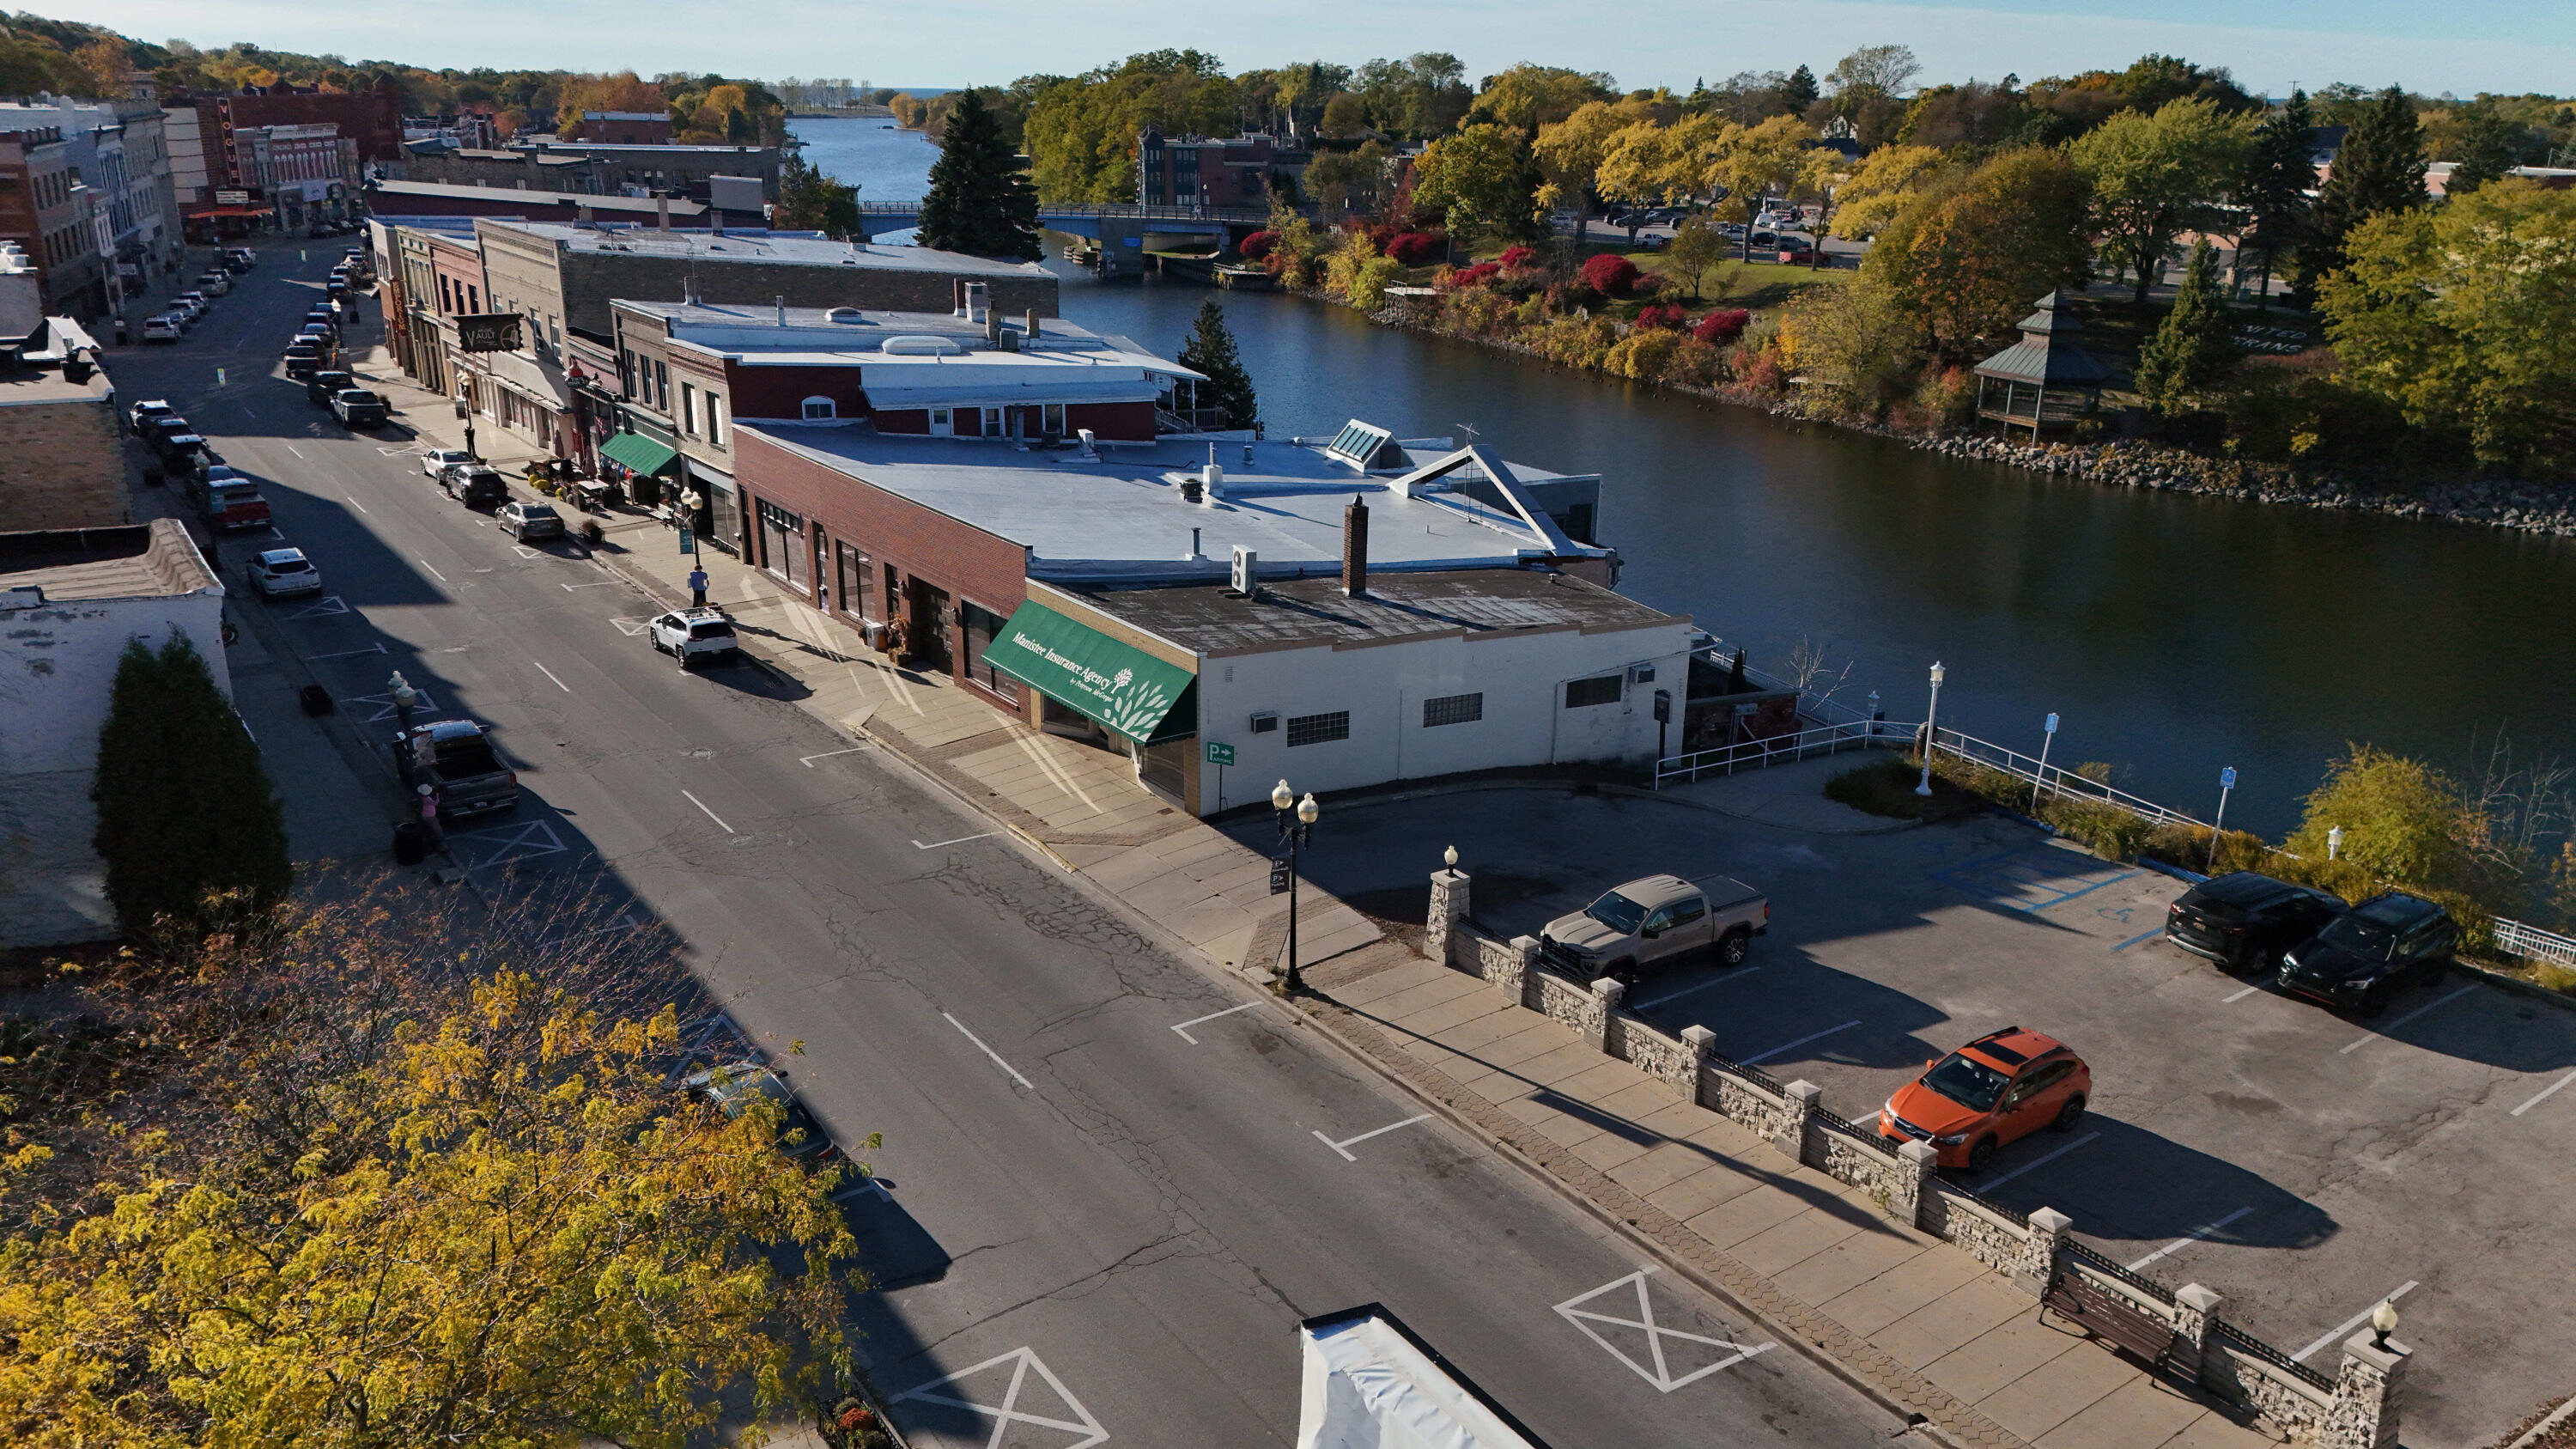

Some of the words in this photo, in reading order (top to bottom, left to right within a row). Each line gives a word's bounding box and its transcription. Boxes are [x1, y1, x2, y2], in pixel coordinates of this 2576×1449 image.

[218, 105, 239, 179] VOGUE
[465, 330, 495, 348] VAULT
[2243, 325, 2307, 340] NITED
[1012, 631, 1047, 656] Manistee
[1044, 648, 1083, 674] Insurance
[1079, 667, 1113, 690] Agency
